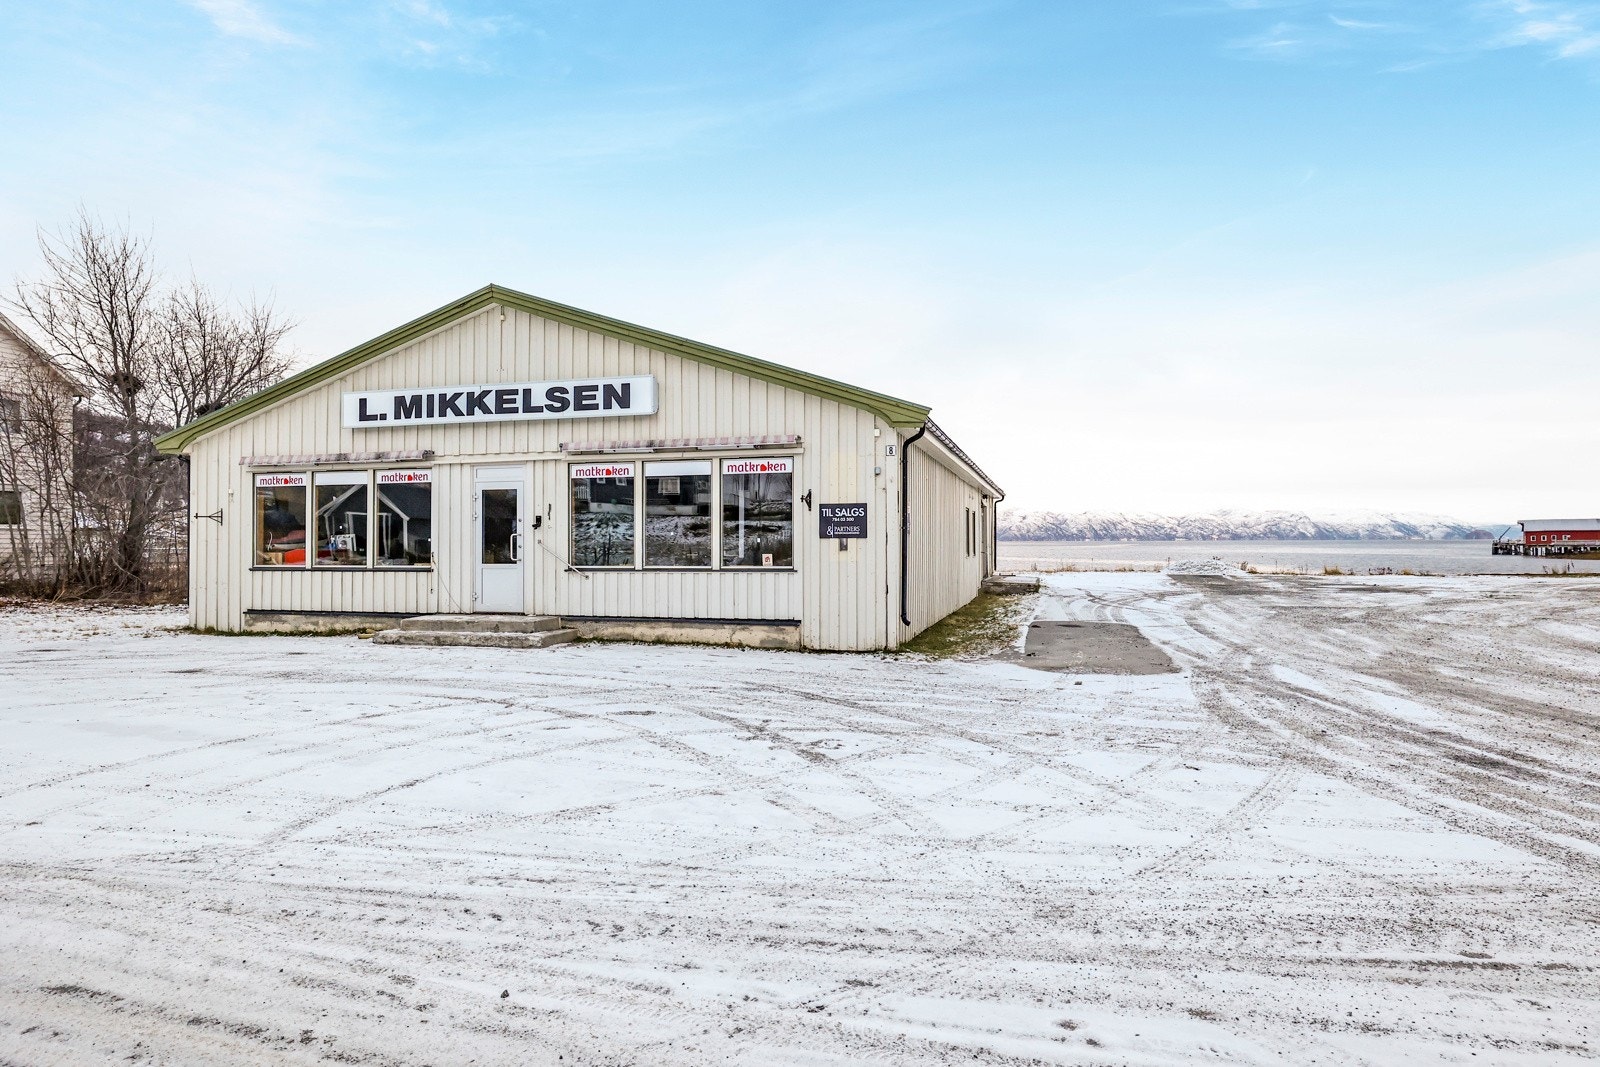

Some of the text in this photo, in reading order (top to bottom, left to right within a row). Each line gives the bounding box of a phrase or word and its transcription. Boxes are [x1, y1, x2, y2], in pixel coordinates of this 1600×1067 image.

[888, 446, 894, 454] 8
[821, 508, 864, 516] TIL SALGS
